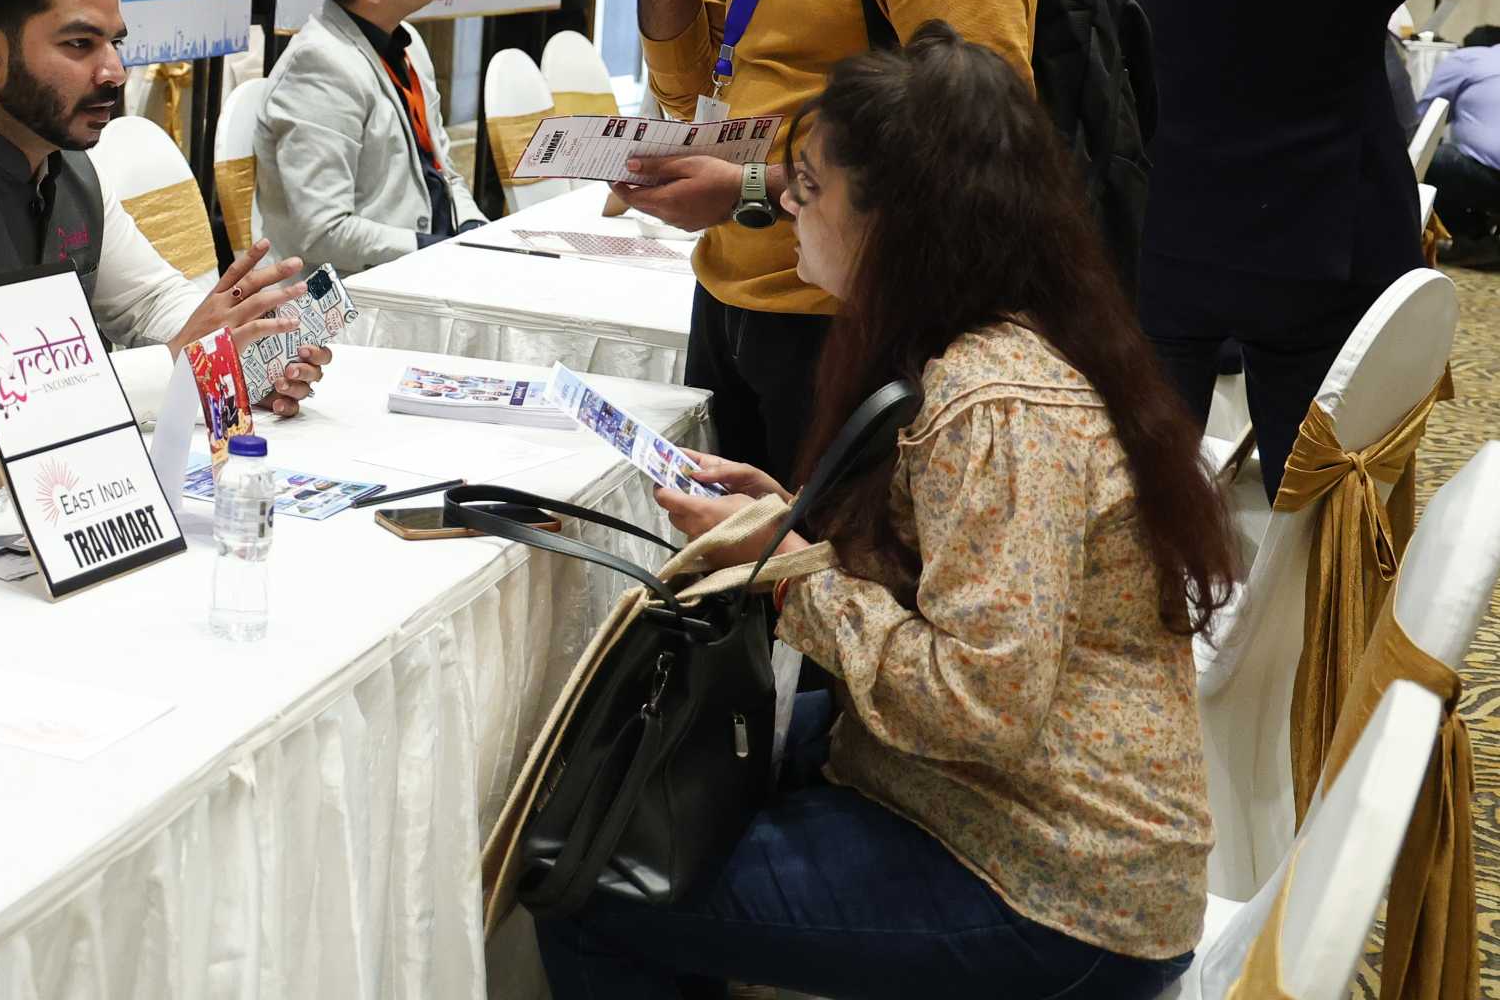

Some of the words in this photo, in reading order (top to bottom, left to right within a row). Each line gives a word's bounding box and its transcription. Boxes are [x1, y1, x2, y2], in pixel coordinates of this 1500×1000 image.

[60, 489, 97, 516] EAST
[97, 477, 138, 503] INDIA
[63, 504, 165, 569] TRAVMART
